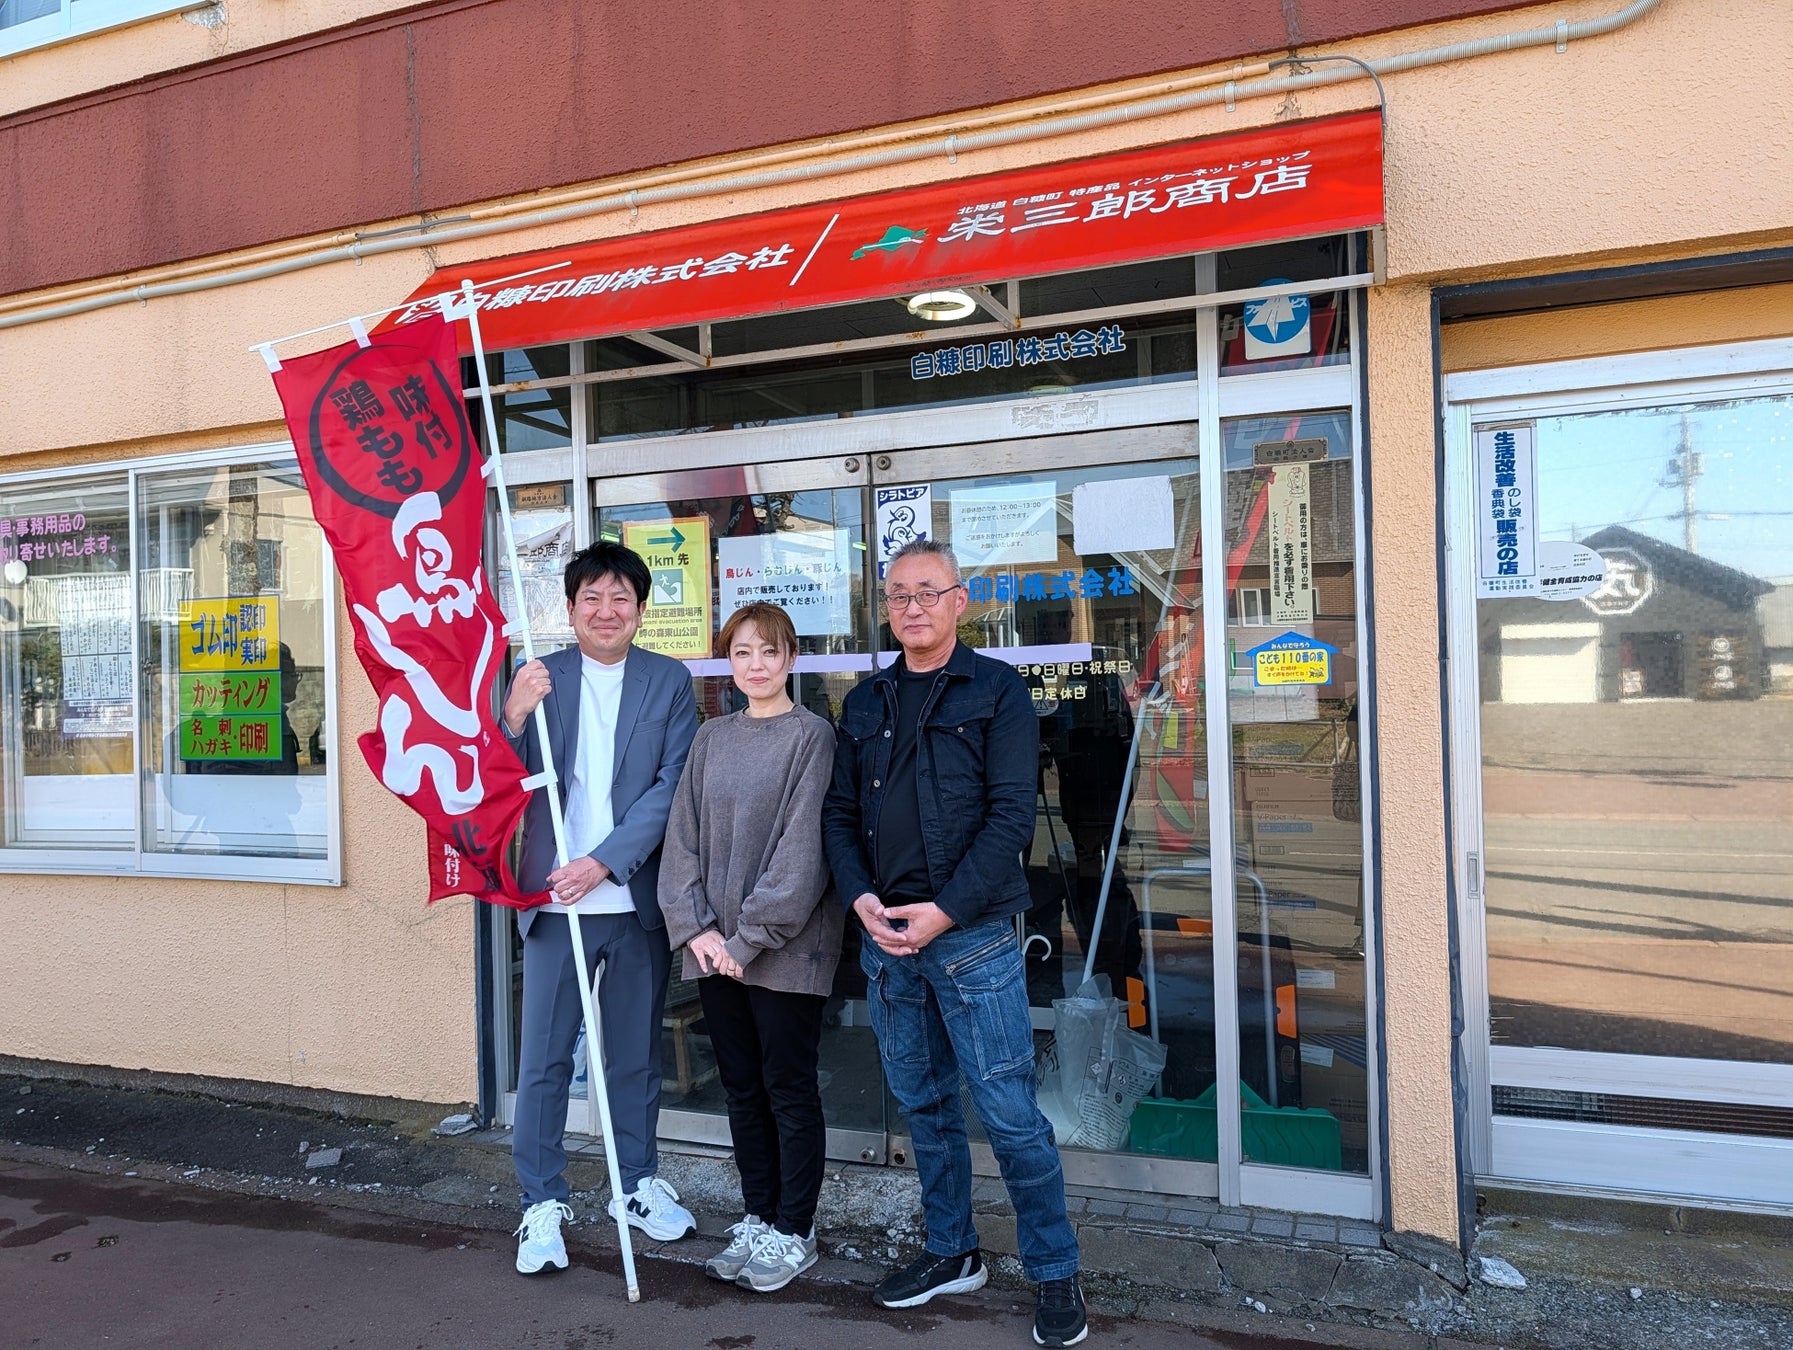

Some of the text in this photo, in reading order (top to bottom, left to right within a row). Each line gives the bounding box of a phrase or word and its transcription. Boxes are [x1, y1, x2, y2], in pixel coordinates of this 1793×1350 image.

[957, 150, 1311, 215] 北海道 白糠町 特産品 インターネットショップ
[937, 164, 1312, 243] 栄三郎商店
[911, 325, 1126, 379] 白糠印刷株式会社
[388, 375, 453, 460] 味付
[329, 379, 424, 495] 鶏もも
[1494, 431, 1516, 487] 生活改善
[879, 488, 925, 500] シラトピア
[1491, 488, 1505, 519] 香典袋
[1507, 487, 1522, 519] のし袋
[647, 553, 690, 567] 1km 先
[1496, 519, 1519, 576] 販売の店
[961, 565, 1136, 604] 印刷株式会社
[1540, 574, 1603, 586] 健全育成協力の店
[239, 604, 266, 632] 認印
[190, 612, 239, 657] ゴム印
[240, 637, 267, 665] 実印
[192, 677, 270, 709] カッティング
[1028, 685, 1086, 700] 日定休日
[191, 738, 232, 755] ハガキ
